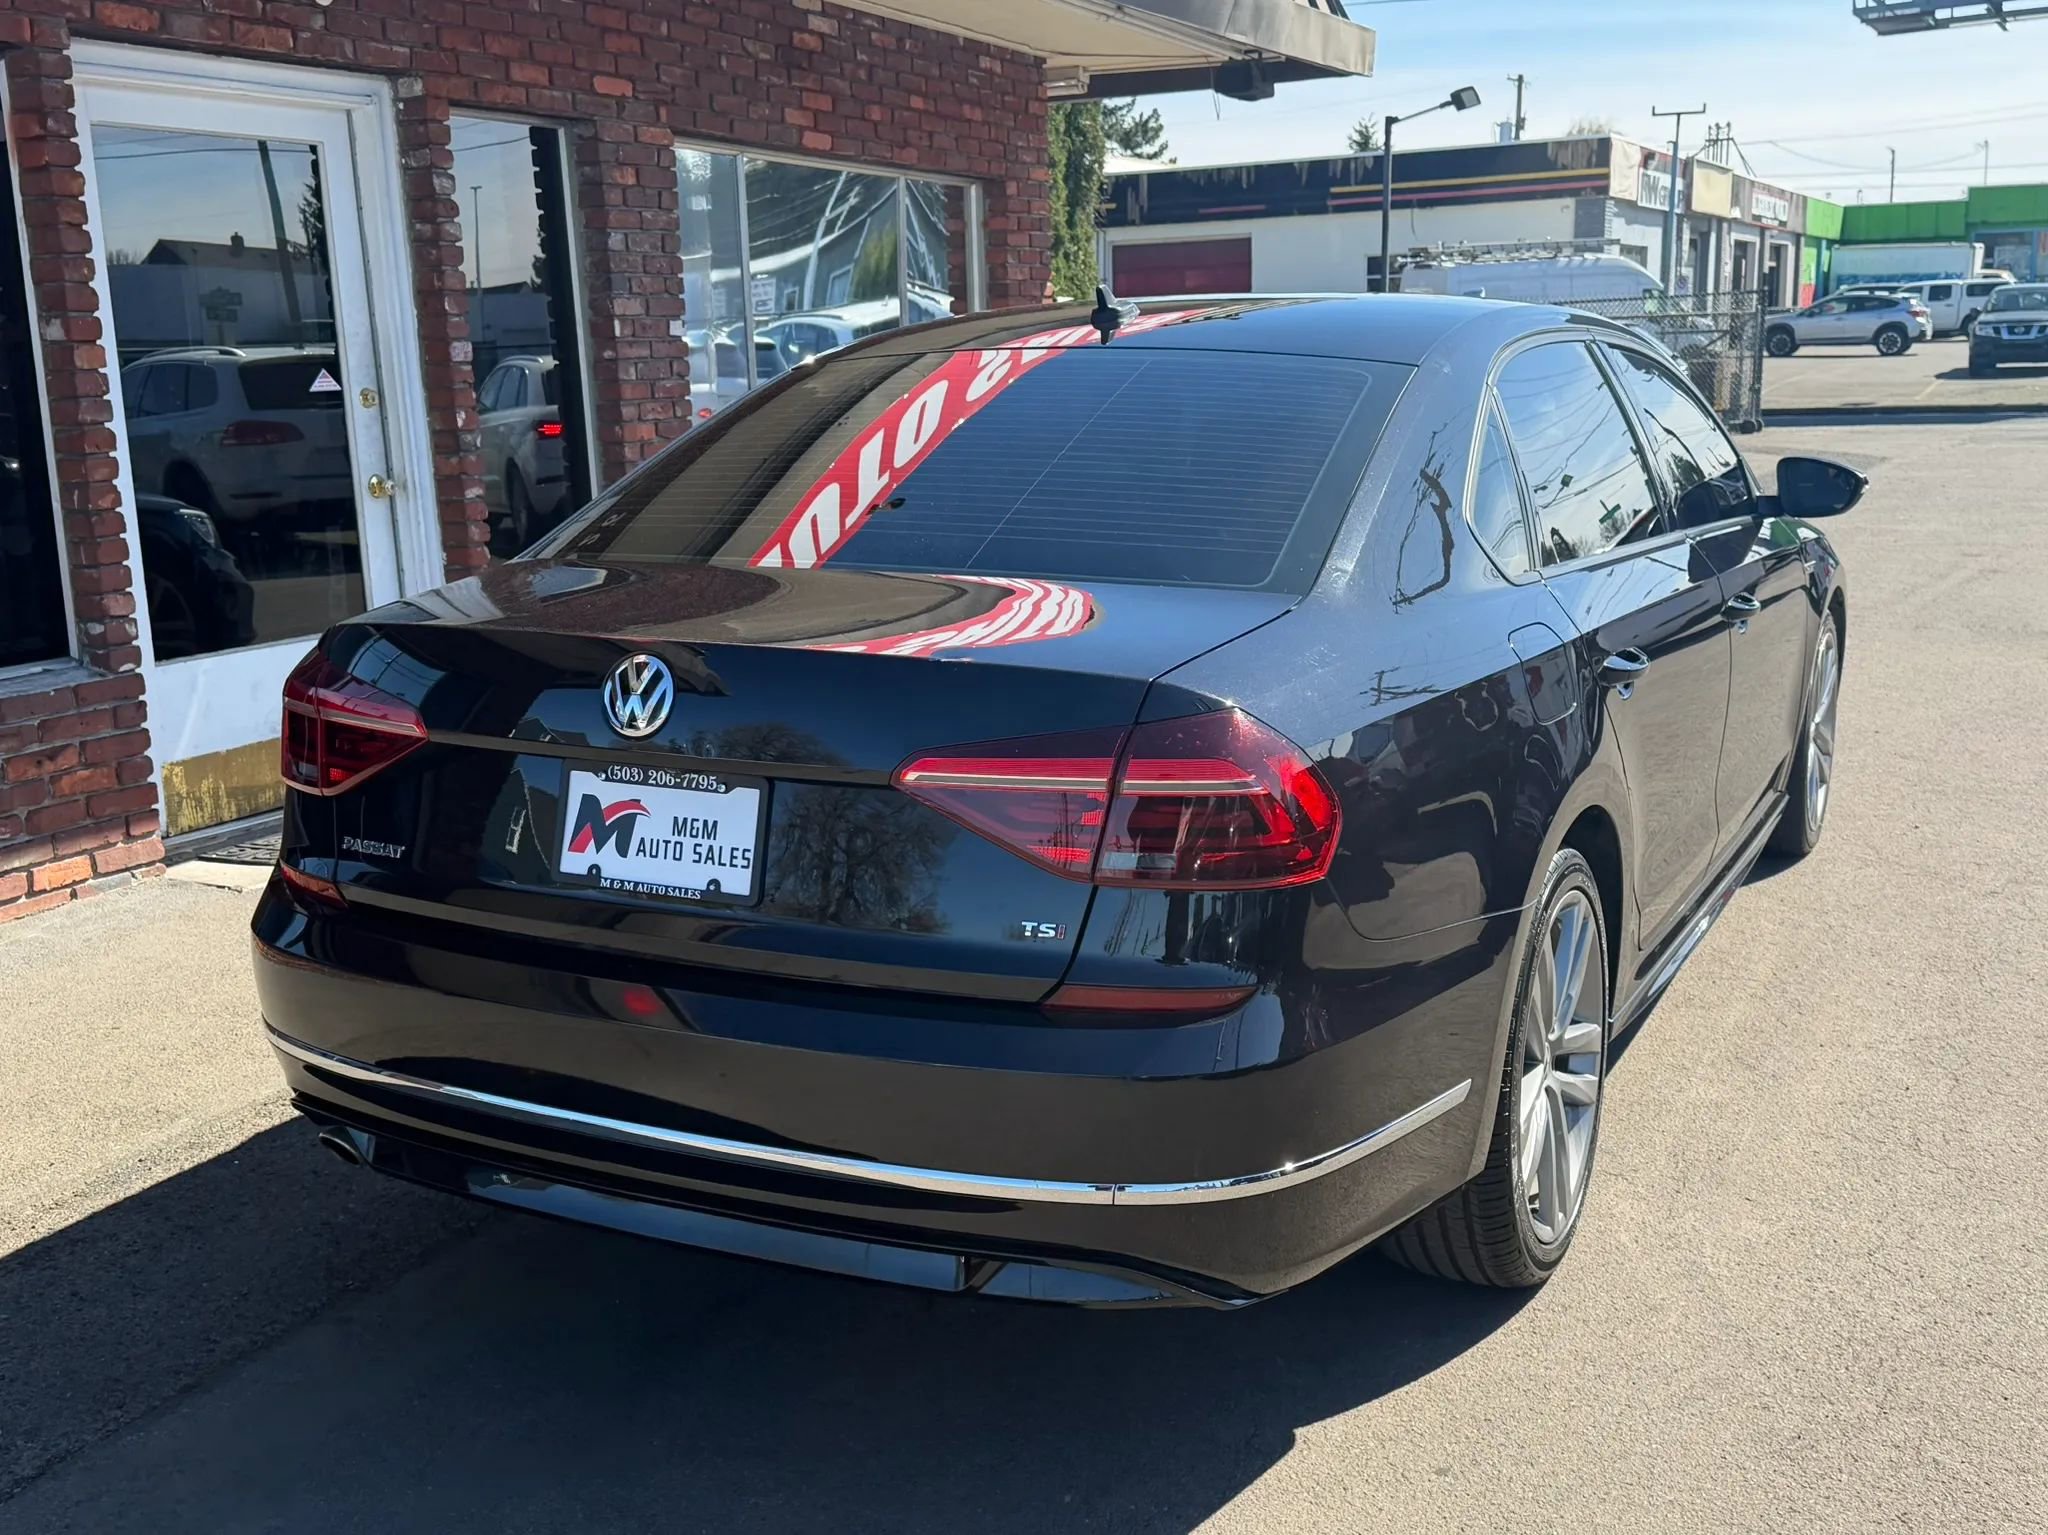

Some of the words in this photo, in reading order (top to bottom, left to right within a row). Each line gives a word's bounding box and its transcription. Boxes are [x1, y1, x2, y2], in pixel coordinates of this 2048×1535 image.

[608, 765, 643, 782] (503)
[648, 769, 717, 790] 206-7795
[672, 816, 718, 840] M&M
[342, 836, 405, 859] PASSAT
[635, 837, 683, 861] AUTO
[692, 843, 752, 869] SALES
[600, 878, 610, 888] M
[613, 880, 621, 889] &
[623, 881, 634, 891] M
[636, 883, 665, 895] AUTO
[667, 887, 701, 899] SALES
